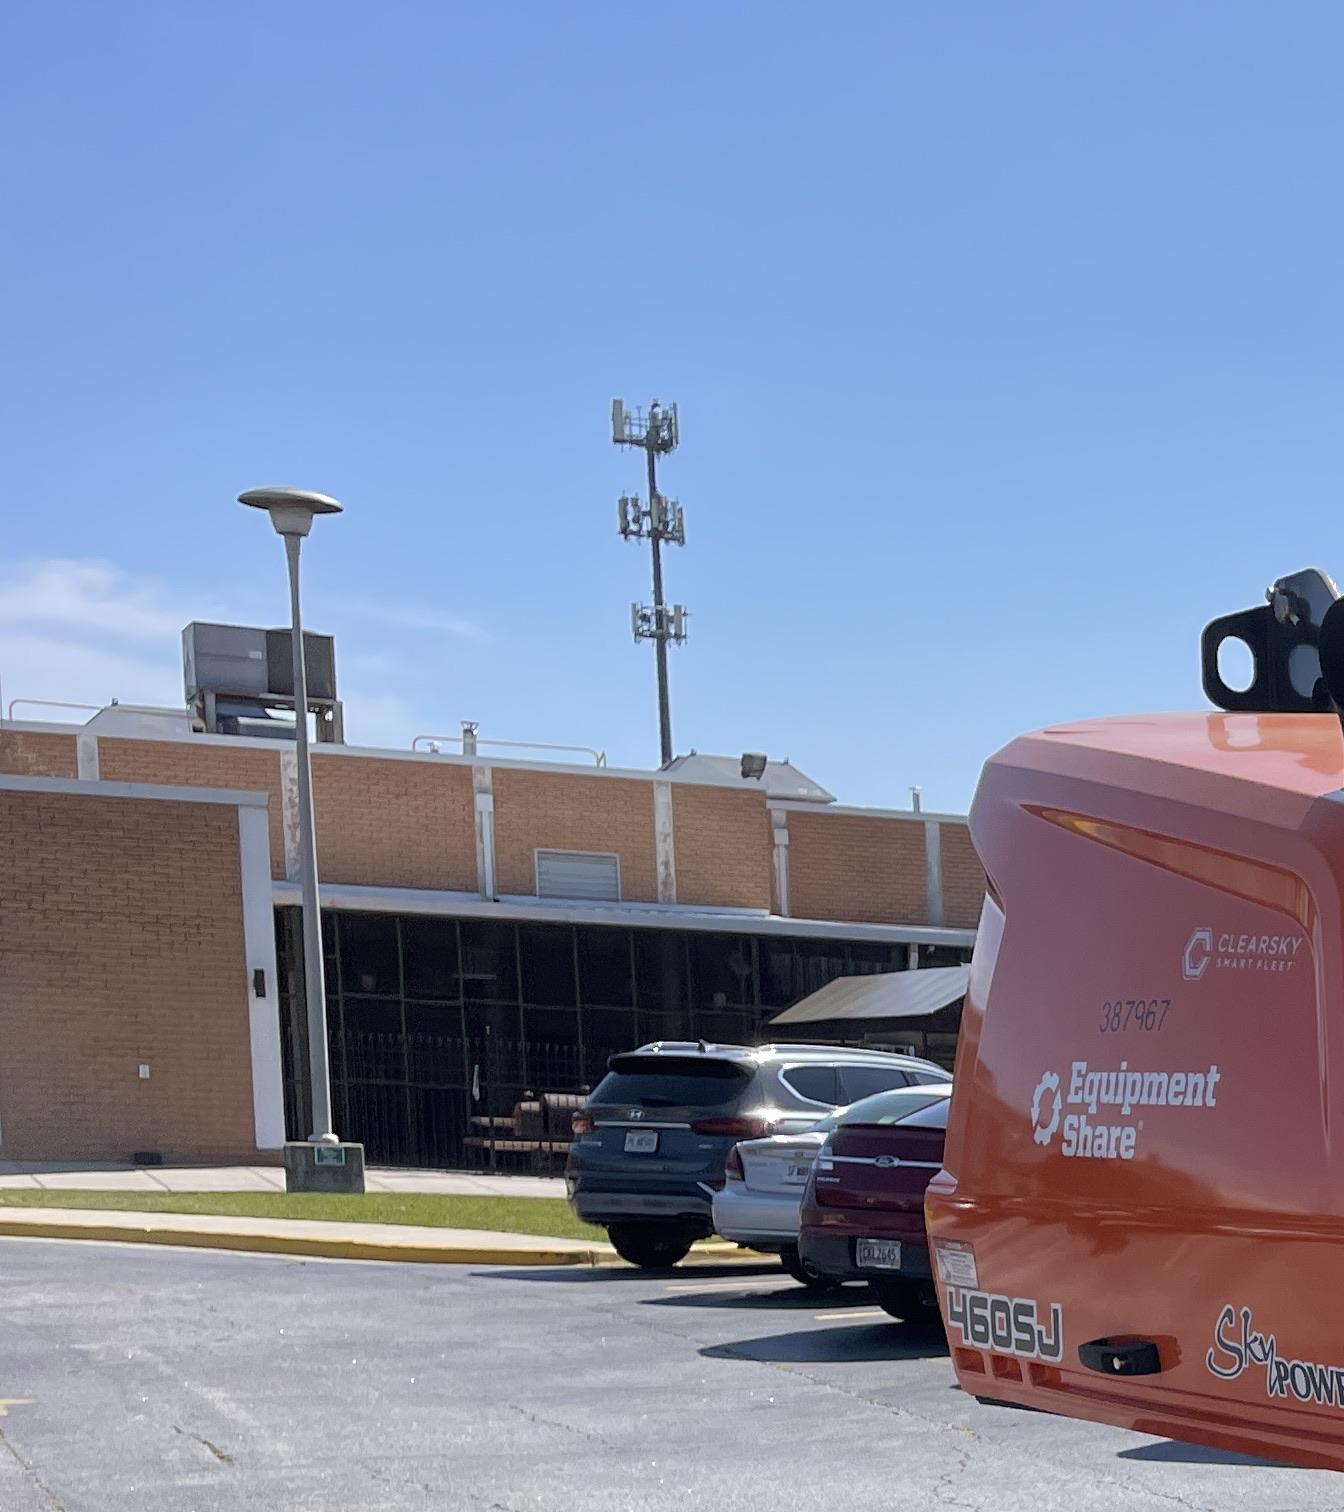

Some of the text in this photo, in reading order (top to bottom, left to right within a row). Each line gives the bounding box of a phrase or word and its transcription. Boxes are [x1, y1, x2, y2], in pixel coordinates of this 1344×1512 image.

[1218, 933, 1302, 955] CLEARSKY
[1216, 958, 1294, 972] SMART FLEET
[1100, 999, 1172, 1033] 387967
[1066, 1060, 1221, 1115] Equipment
[1061, 1114, 1137, 1160] Share
[947, 1287, 1063, 1361] 460SJ
